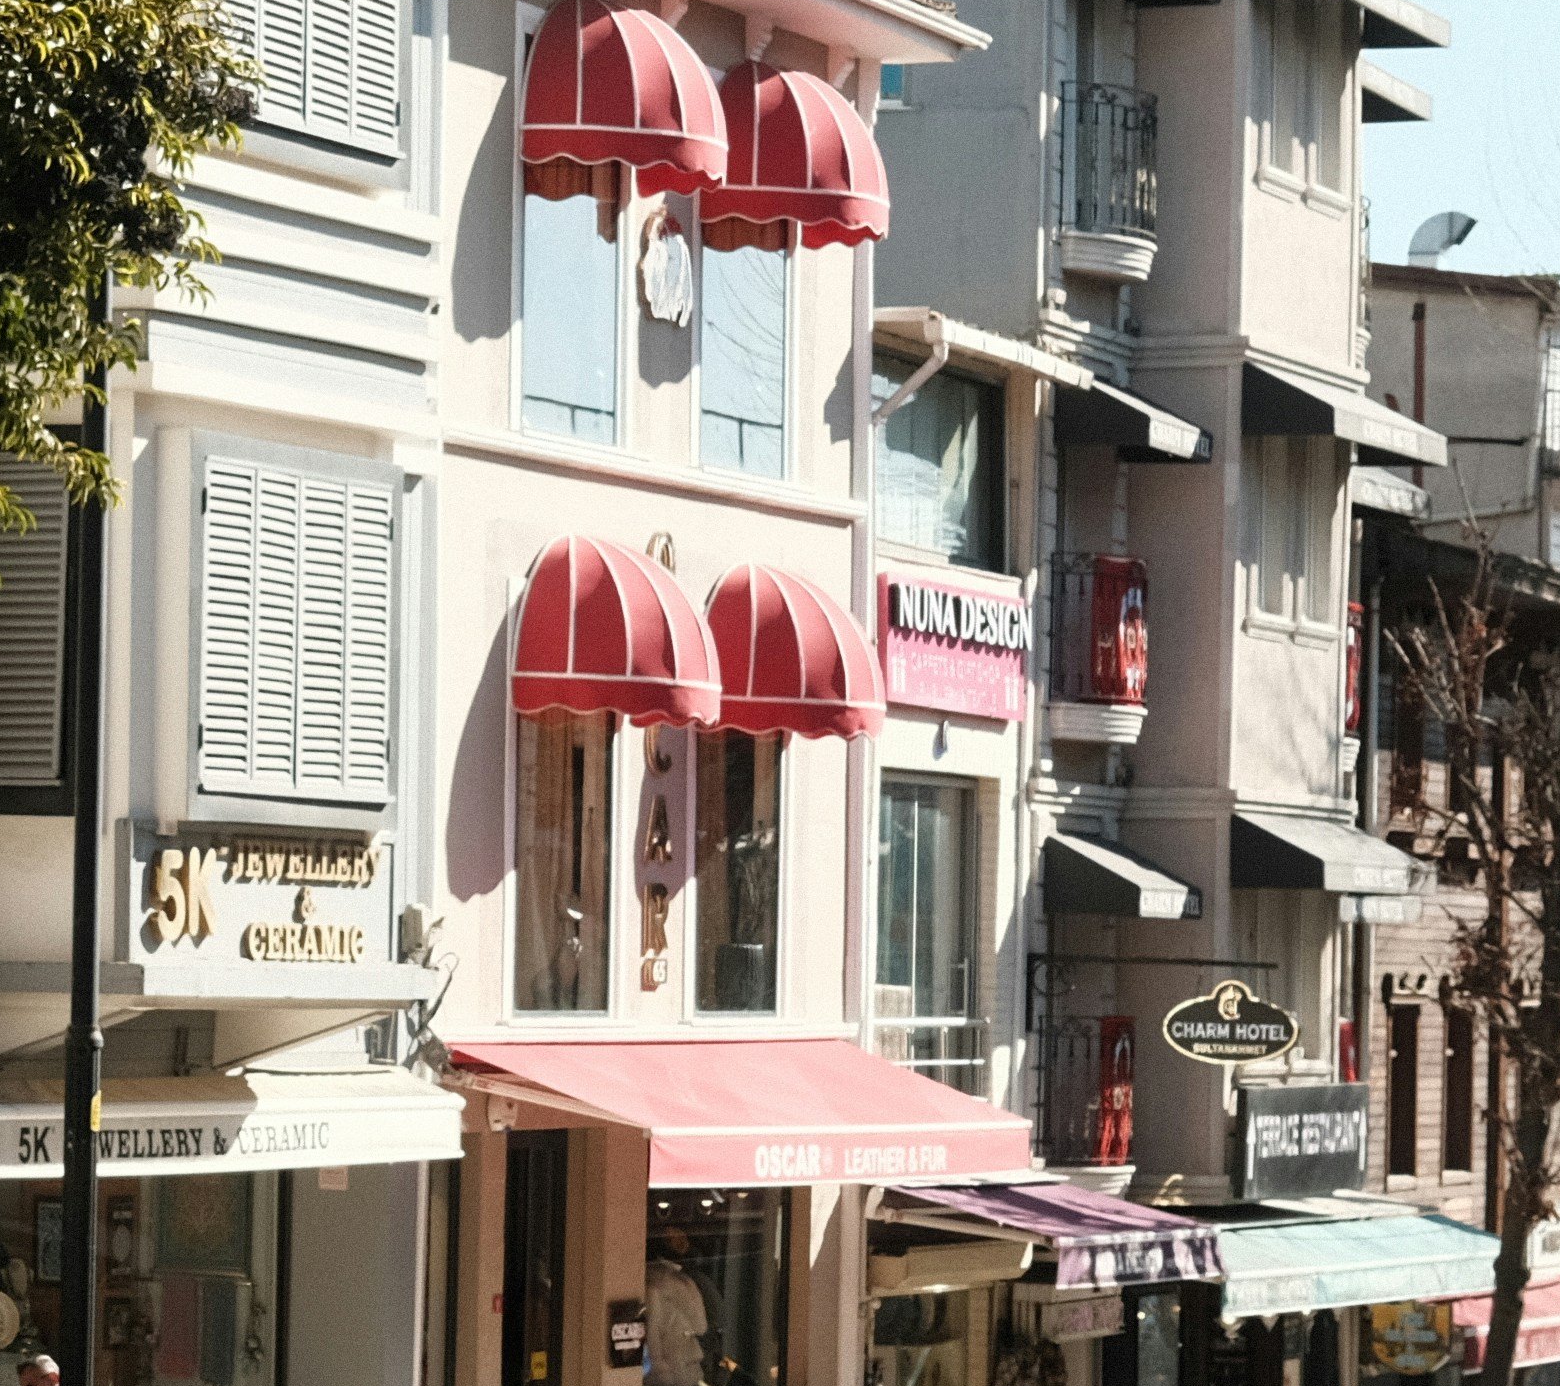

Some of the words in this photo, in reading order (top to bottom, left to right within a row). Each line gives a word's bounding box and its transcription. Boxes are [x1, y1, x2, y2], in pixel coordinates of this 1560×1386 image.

[898, 582, 958, 638] NUNA
[959, 595, 1033, 652] DESIGN
[231, 839, 382, 883] JEWELLERY
[301, 885, 317, 918] &
[248, 922, 367, 962] CERAMIC
[1171, 1020, 1230, 1039] CHARM
[1235, 1023, 1289, 1041] HOTEL
[97, 1127, 203, 1159] WELLERY
[213, 1127, 229, 1156] &
[236, 1121, 331, 1155] CERAMIC
[844, 1146, 906, 1175] LEATHER
[920, 1145, 948, 1172] FUR
